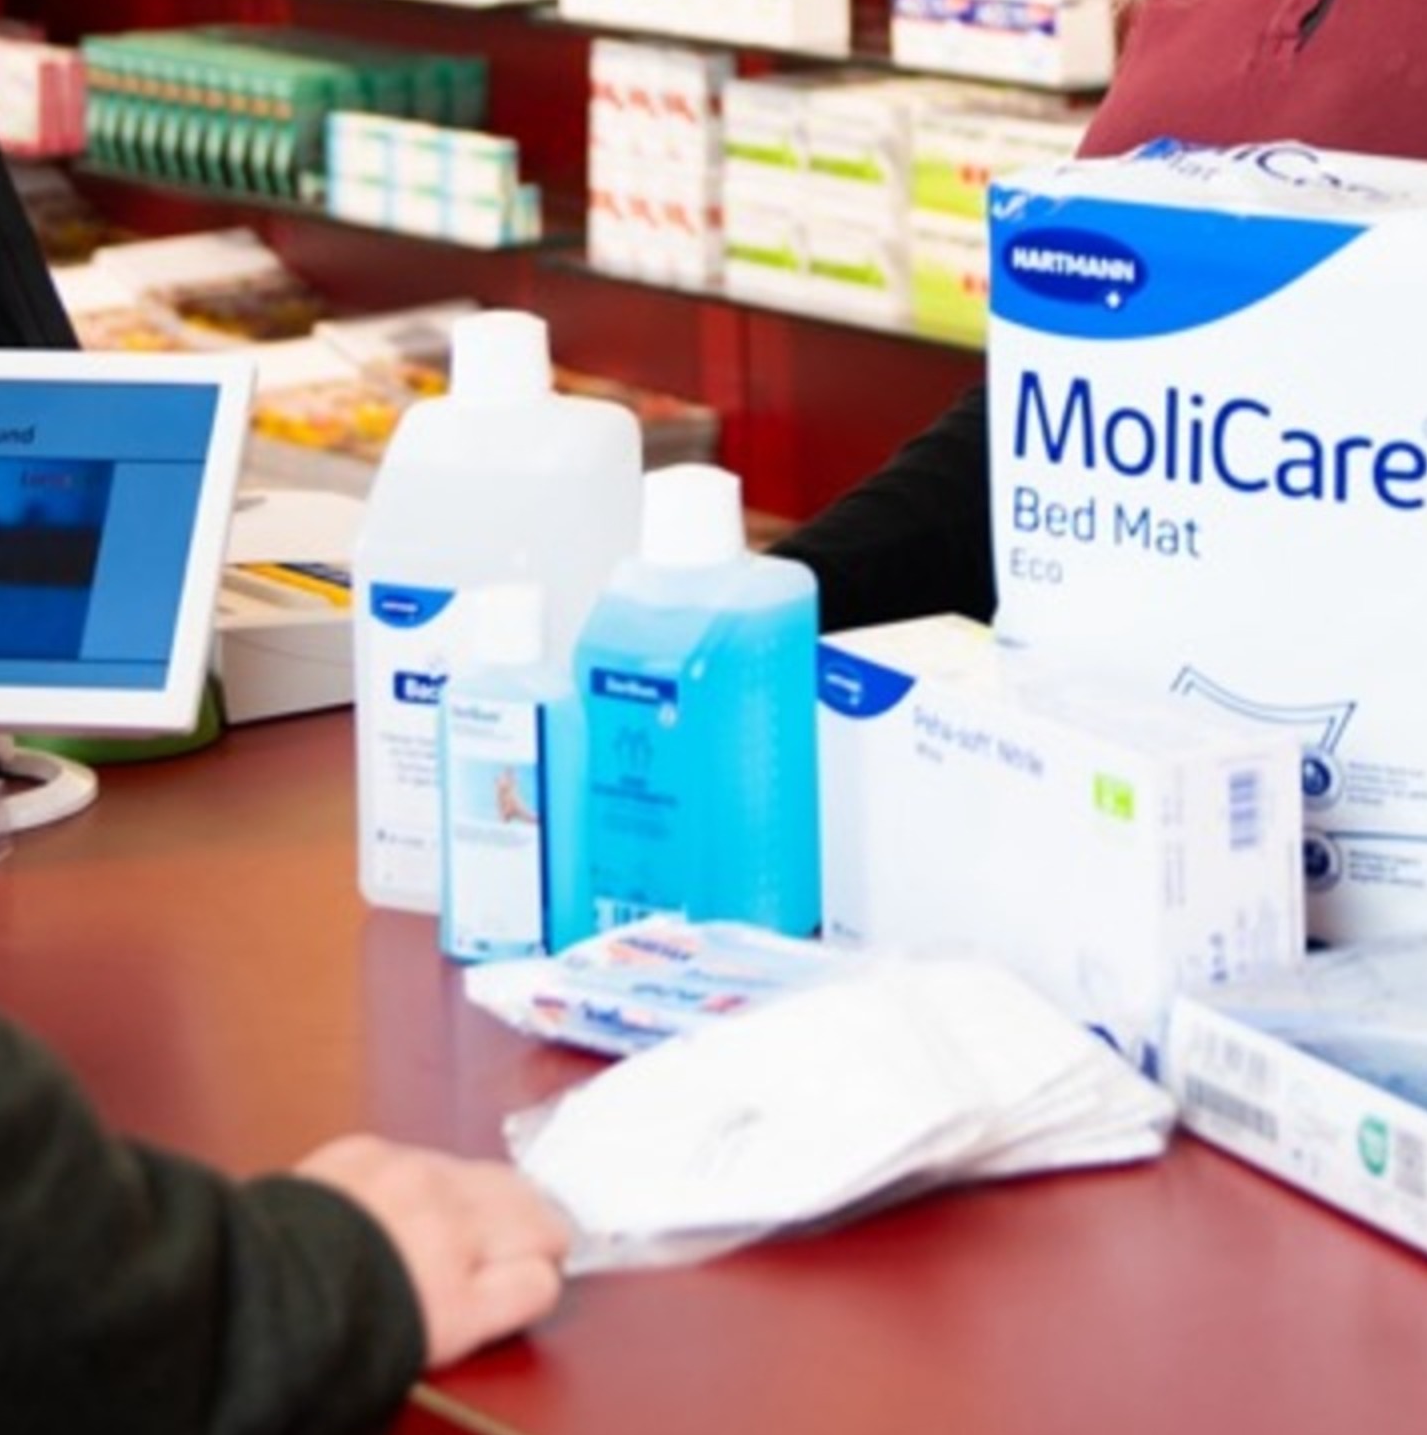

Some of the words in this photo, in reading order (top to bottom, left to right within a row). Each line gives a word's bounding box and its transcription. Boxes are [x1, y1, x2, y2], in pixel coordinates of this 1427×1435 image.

[1011, 246, 1136, 283] HARTMANN
[1012, 486, 1097, 543] Bed
[1113, 503, 1202, 558] Mat
[1009, 547, 1064, 585] Eco
